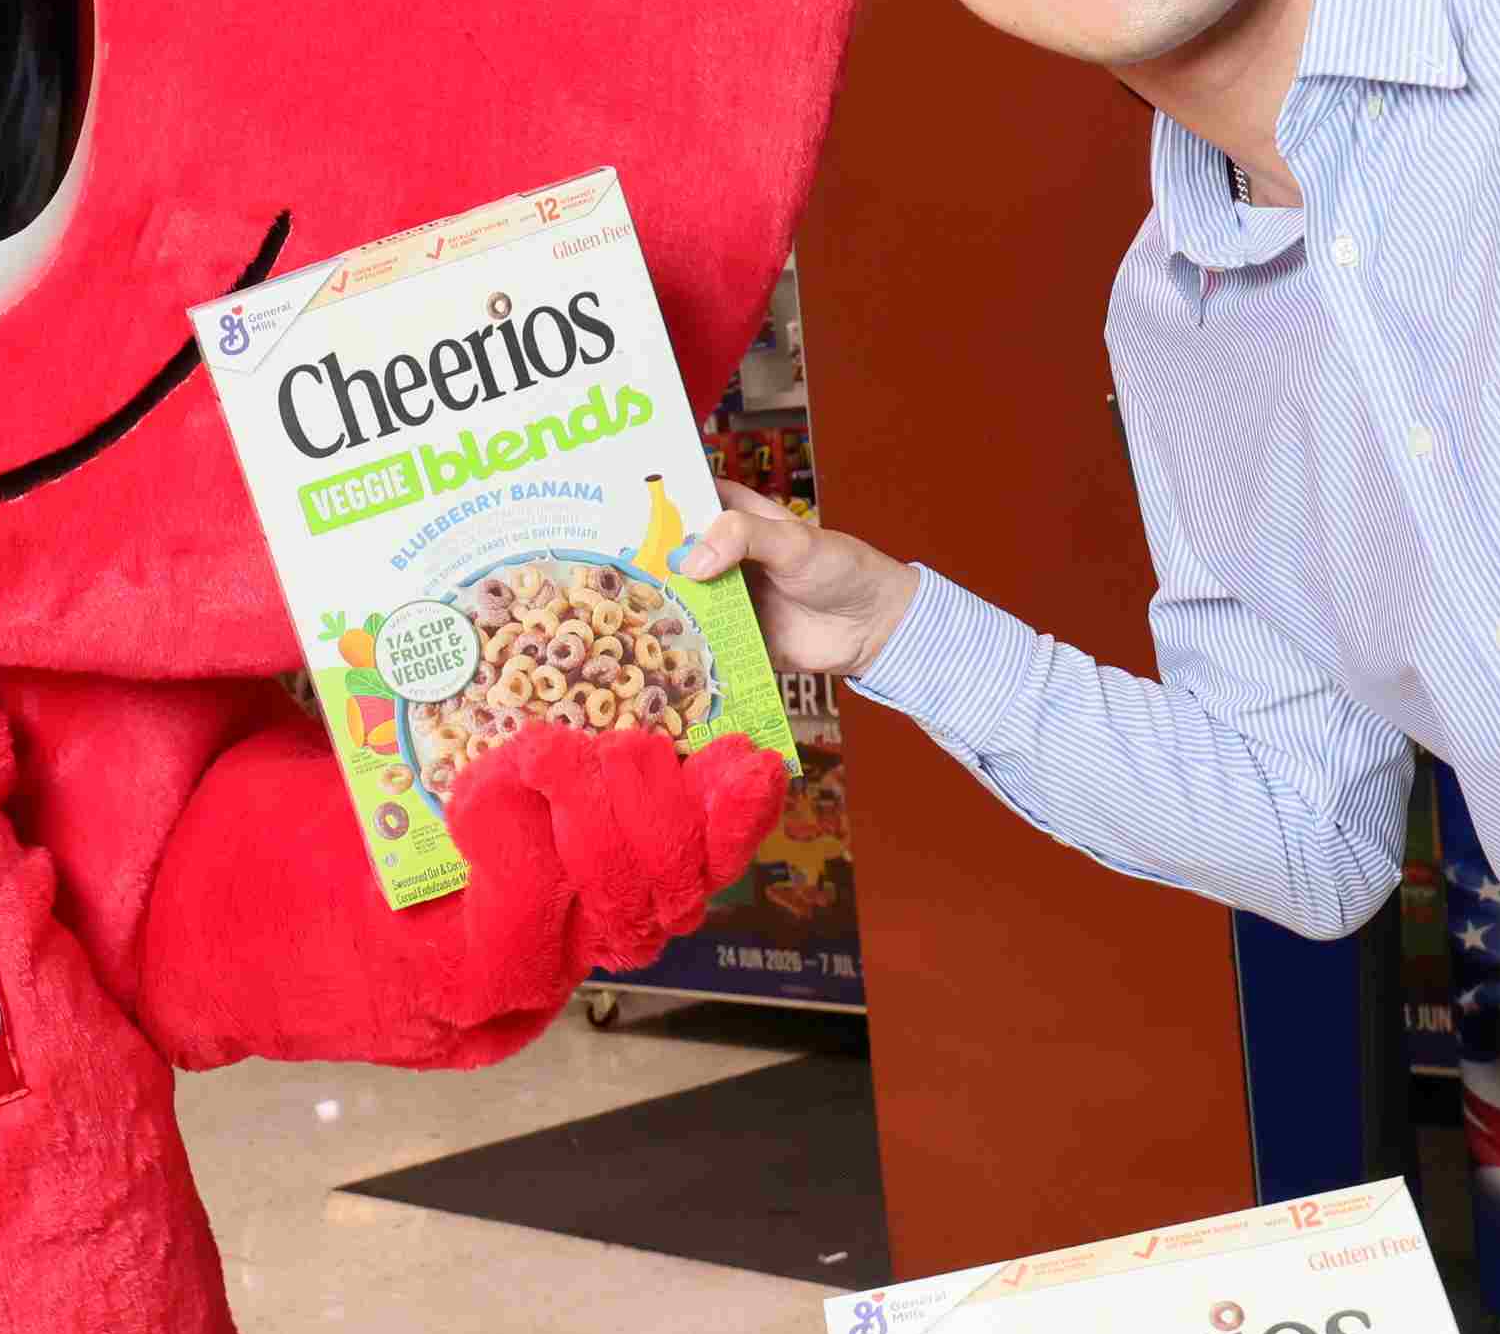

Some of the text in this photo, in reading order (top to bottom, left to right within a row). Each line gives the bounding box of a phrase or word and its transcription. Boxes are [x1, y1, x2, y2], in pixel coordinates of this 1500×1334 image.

[534, 196, 560, 225] 12
[552, 223, 632, 260] Gluten Free
[247, 301, 293, 324] General
[251, 320, 278, 334] Mills
[277, 291, 617, 460] Cheerios
[310, 382, 655, 521] VEGGIE blends
[390, 481, 605, 571] BLUEBERRY BANANA
[387, 618, 456, 650] 1/4 CUP
[390, 638, 442, 664] FRUIT
[1287, 1201, 1323, 1230] 12
[1307, 1231, 1424, 1274] Gluten Free
